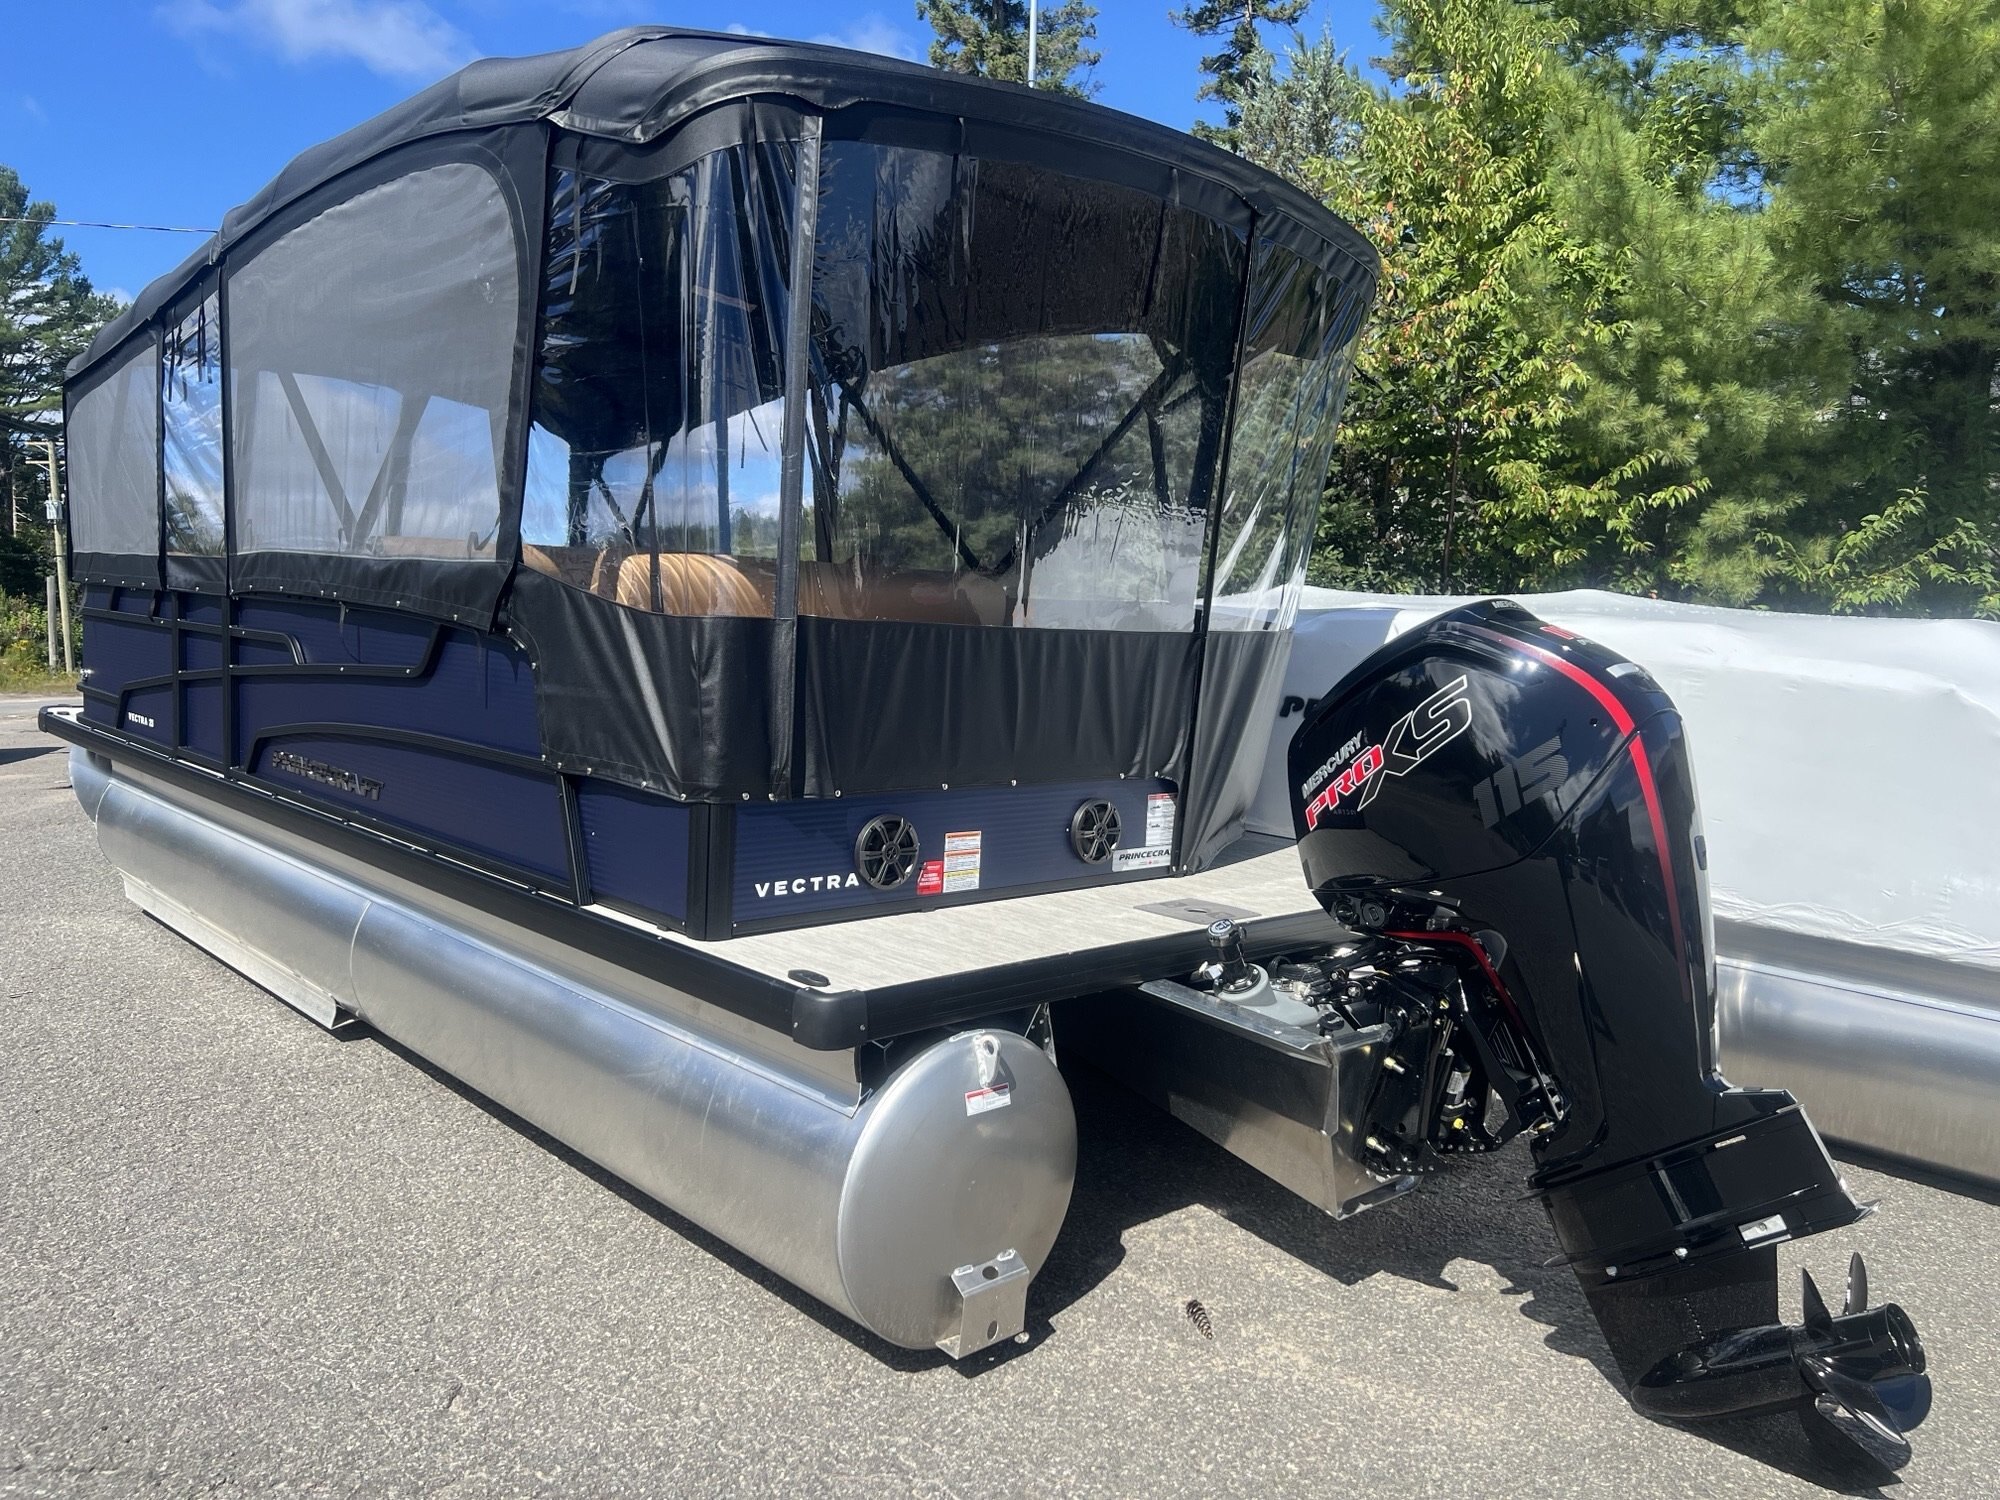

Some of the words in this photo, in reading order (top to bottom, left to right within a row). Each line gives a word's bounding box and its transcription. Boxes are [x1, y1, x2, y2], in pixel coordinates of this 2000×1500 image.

[128, 711, 148, 726] VECTRA
[1301, 730, 1362, 799] MERCURY
[1305, 744, 1384, 832] PRO
[1472, 735, 1569, 829] 115
[754, 872, 860, 898] VECTRA
